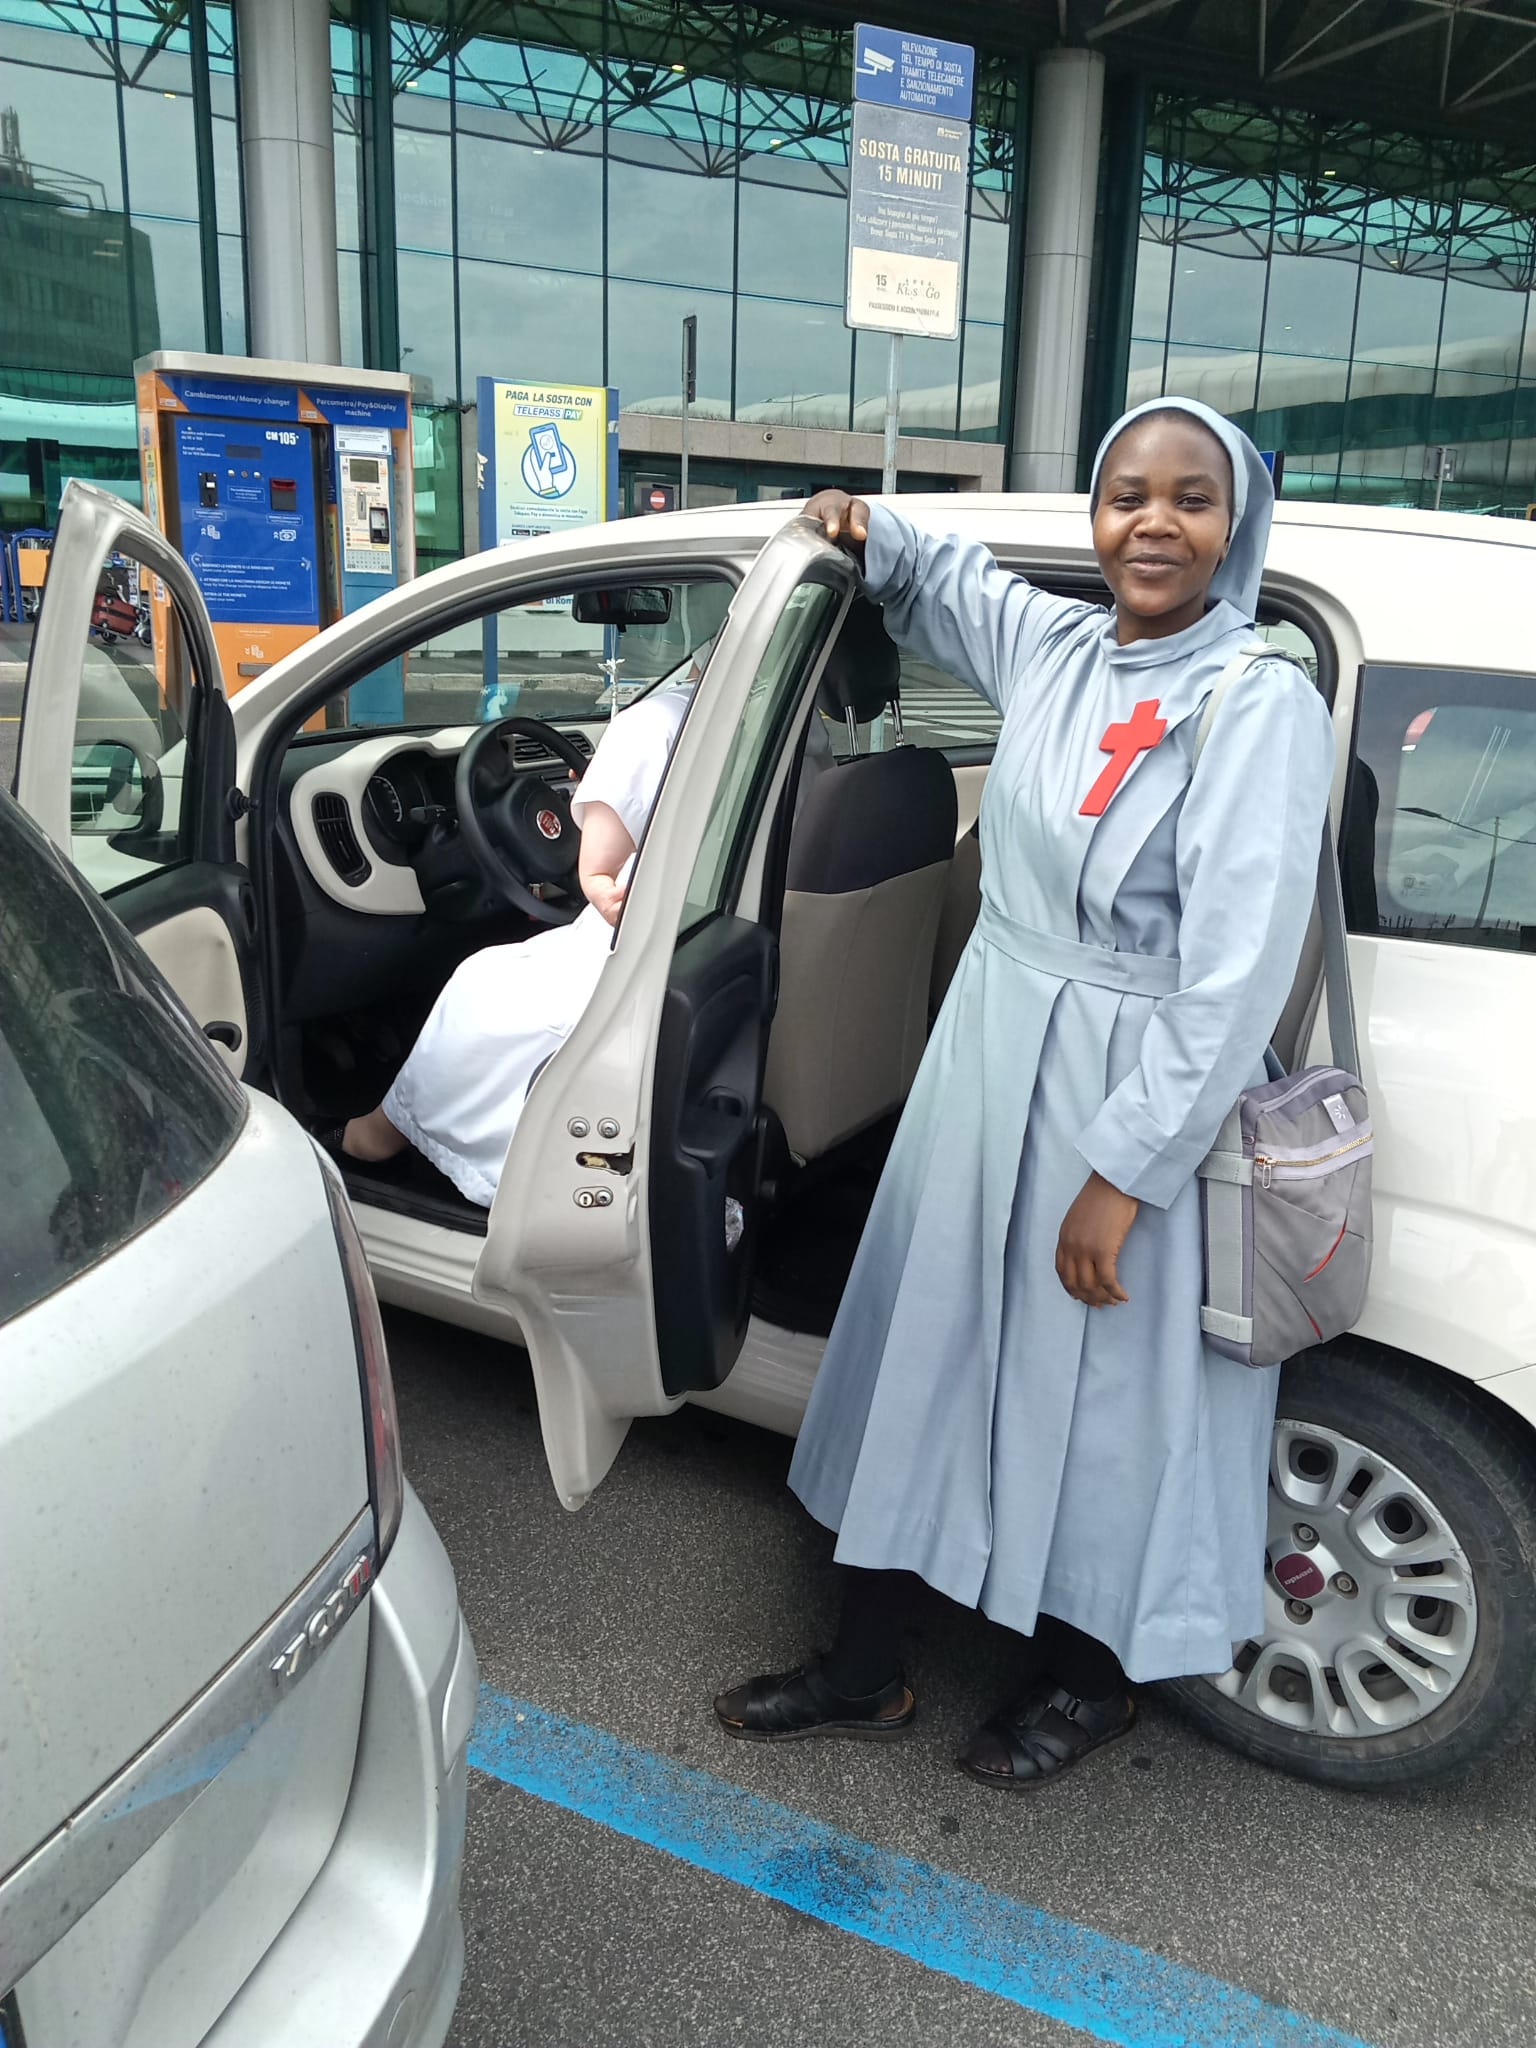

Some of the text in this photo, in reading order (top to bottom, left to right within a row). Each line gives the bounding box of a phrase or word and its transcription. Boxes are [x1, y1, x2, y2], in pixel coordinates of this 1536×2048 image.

[901, 41, 938, 58] RILEVAZIONE
[901, 53, 962, 74] DEL TEMPO DI SOSTA
[901, 65, 965, 87] TRAMITE TELECAMERE
[905, 79, 954, 97] SANZIONAMENTO
[899, 90, 936, 106] AUTOMATICO
[859, 138, 961, 173] SOSTA GRATUITA
[879, 165, 942, 190] 15 MINUTI
[876, 273, 887, 286] 15
[925, 287, 940, 300] Go
[263, 396, 291, 407] changer
[505, 390, 593, 407] PAGA LA SOSTA CON
[345, 409, 371, 417] machine
[516, 406, 582, 420] TELEPASS PAY
